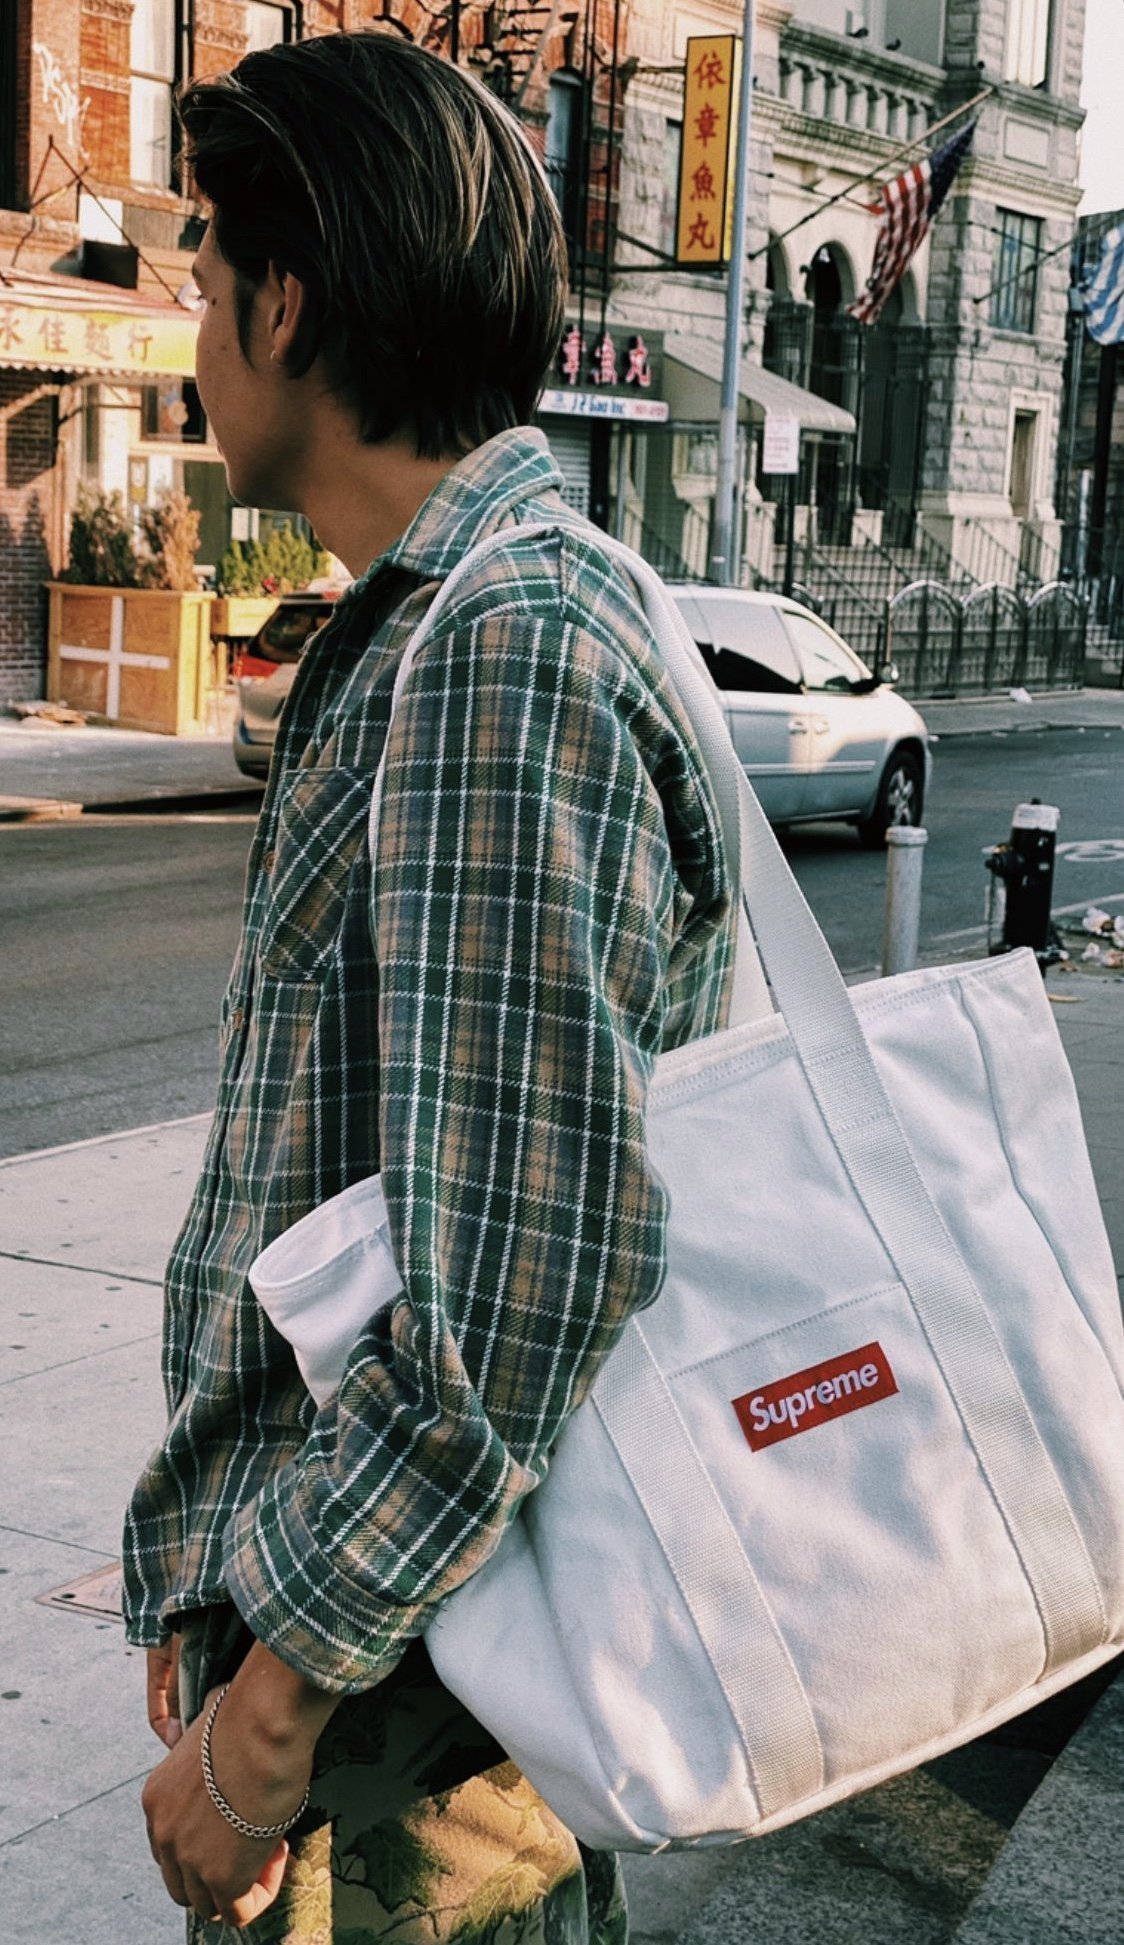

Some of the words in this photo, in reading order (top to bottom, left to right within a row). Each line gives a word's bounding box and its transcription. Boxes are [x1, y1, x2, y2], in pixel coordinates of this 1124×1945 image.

[687, 50, 726, 249] 依章魚丸
[749, 1363, 878, 1431] Supreme
